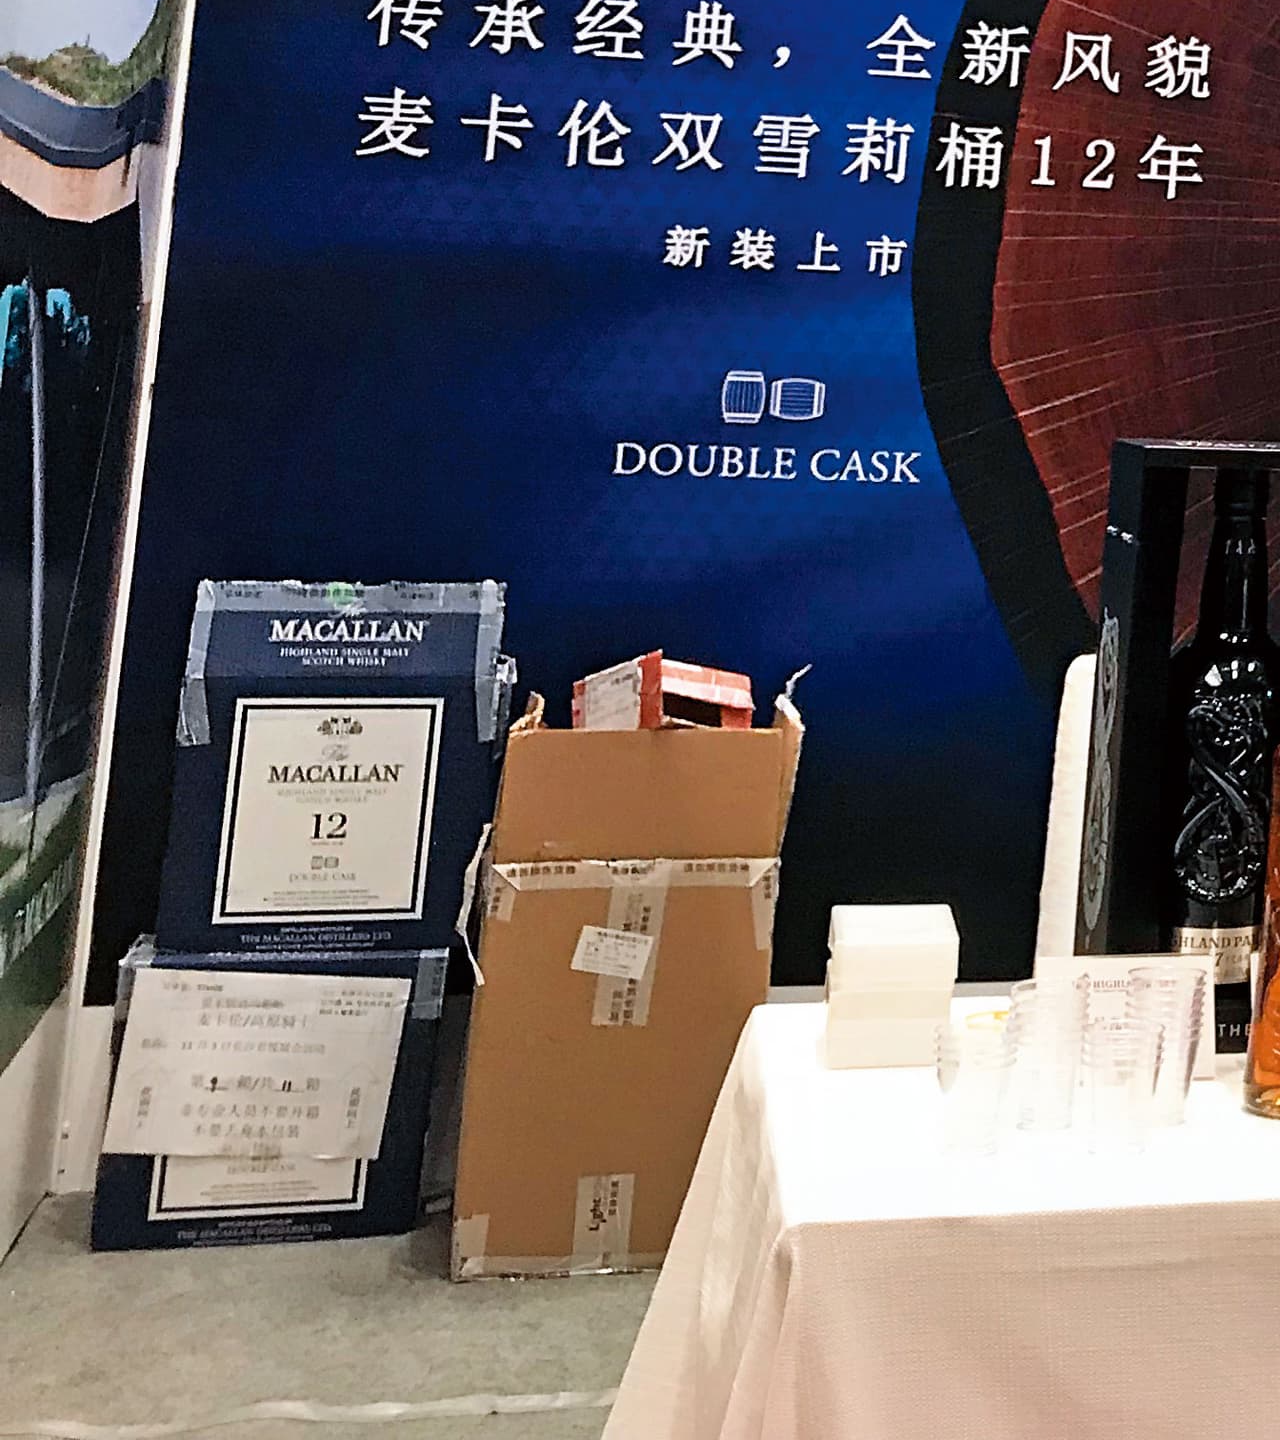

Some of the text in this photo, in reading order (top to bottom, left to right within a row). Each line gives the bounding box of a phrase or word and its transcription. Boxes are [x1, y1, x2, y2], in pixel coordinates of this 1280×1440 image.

[355, 87, 1206, 201] 麦卡伦双雪莉桶12年
[663, 225, 910, 278] 新装上市
[612, 442, 922, 486] DOUBLE CASK
[268, 619, 428, 643] MACALLAN
[268, 764, 402, 784] MACALLAN
[310, 812, 348, 840] 12
